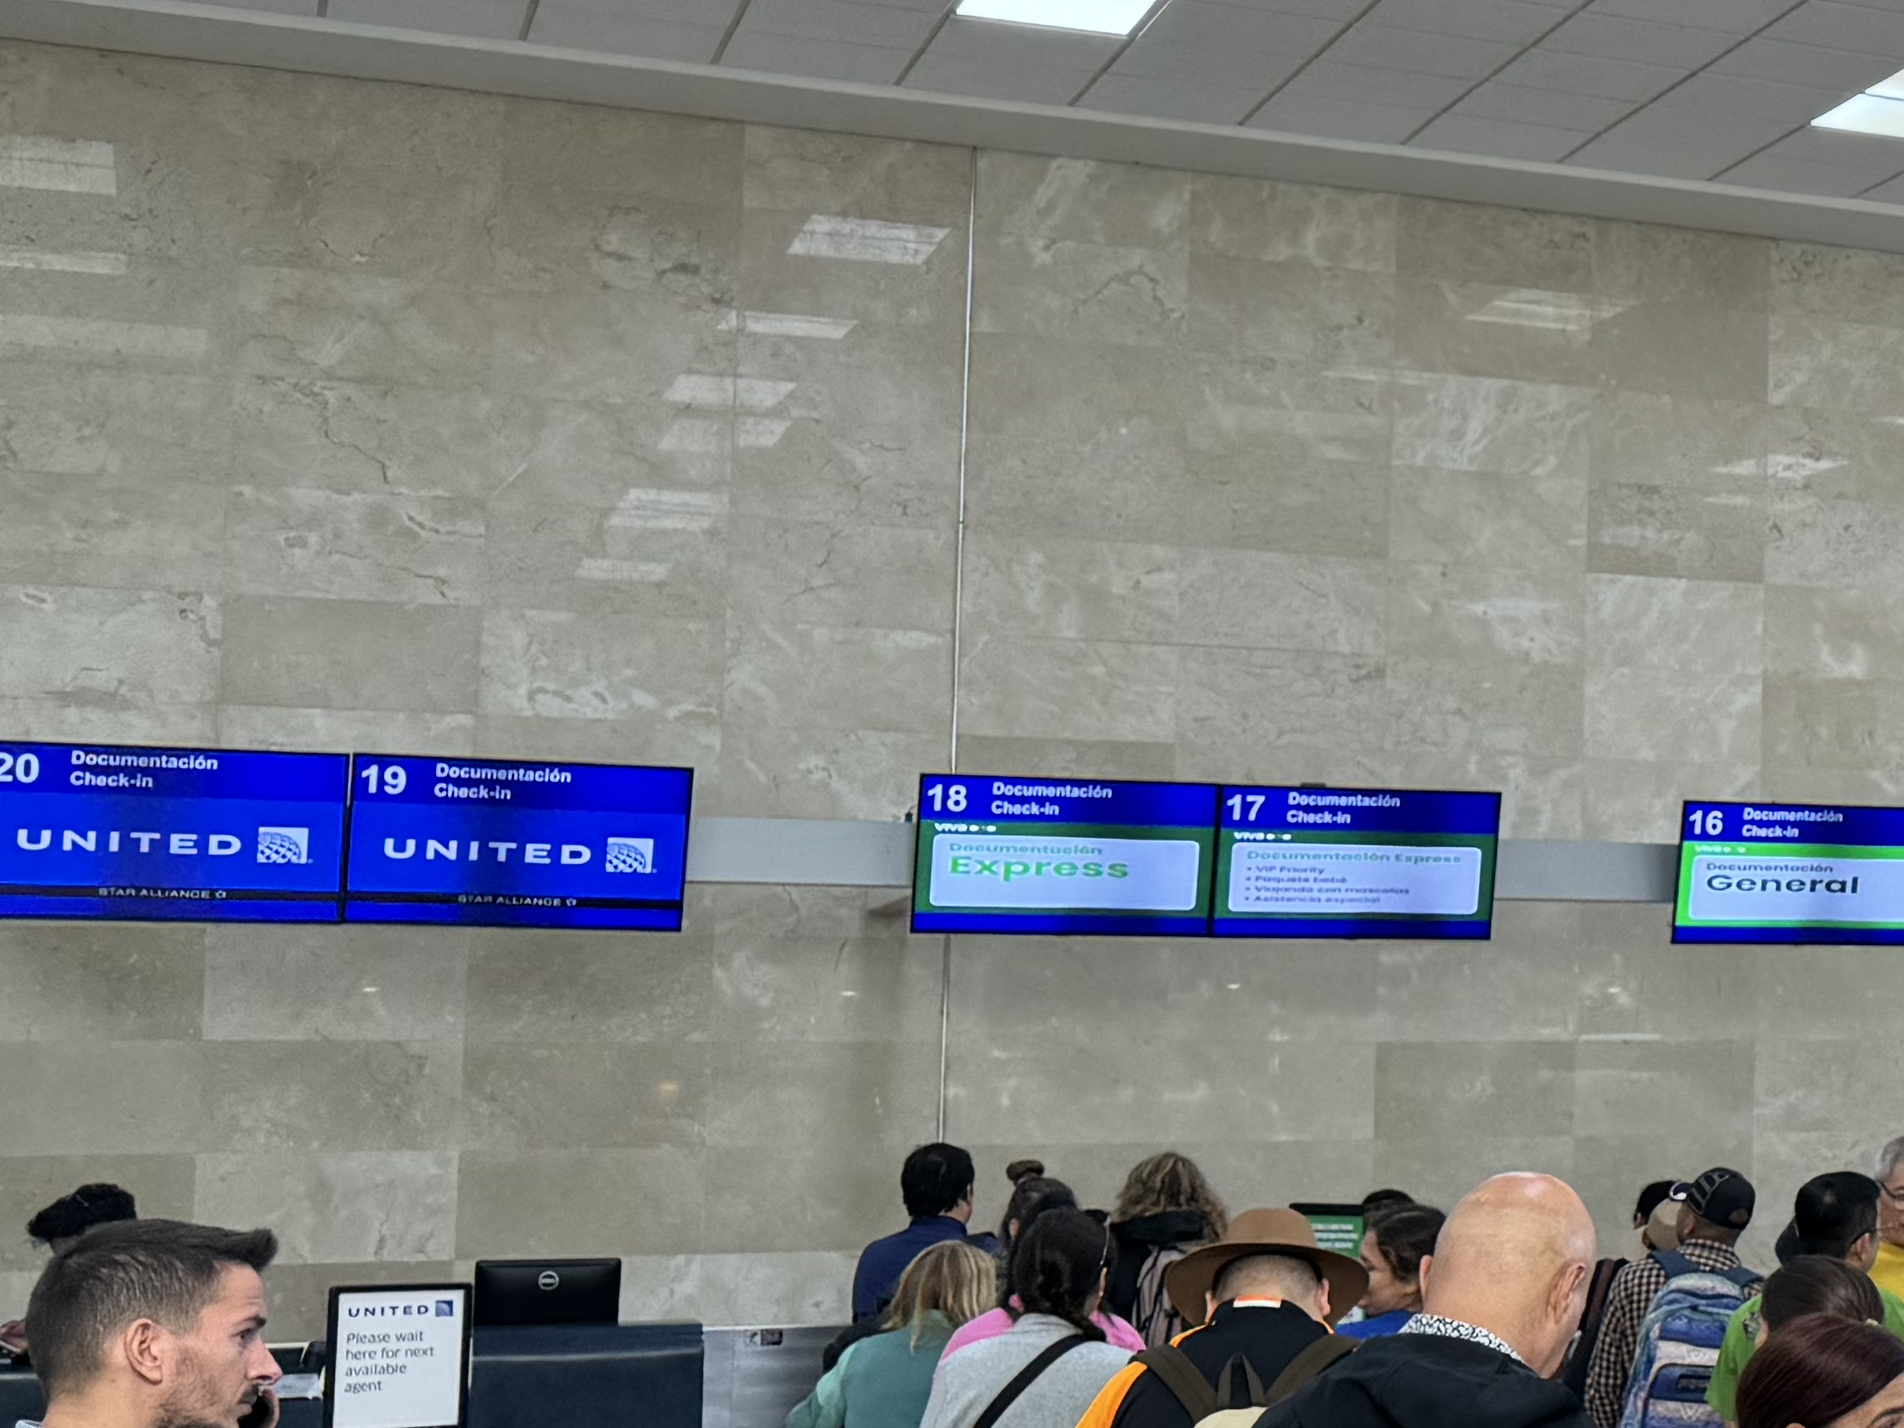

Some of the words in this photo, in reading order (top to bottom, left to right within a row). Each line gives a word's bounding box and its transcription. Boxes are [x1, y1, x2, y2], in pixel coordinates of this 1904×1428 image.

[71, 750, 218, 770] Documentación
[69, 771, 154, 788] Check-in
[360, 764, 407, 795] 19
[435, 763, 572, 784] Documentación
[434, 782, 512, 800] Check-in
[926, 783, 968, 812] 18
[992, 781, 1112, 799] Documentación
[990, 800, 1060, 816] Check-in
[1226, 794, 1266, 822] 17
[1288, 791, 1400, 808] Documentación
[1286, 810, 1351, 824] Check-in
[1688, 809, 1724, 836] 16
[1743, 807, 1843, 822] Documentación
[1742, 824, 1799, 838] Check-in
[16, 828, 242, 856] UNITED
[950, 842, 1102, 856] Documentación
[383, 837, 592, 865] UNITED
[950, 856, 1129, 882] Express
[1706, 862, 1833, 874] Documentación
[98, 887, 136, 897] STAR
[139, 888, 211, 899] ALLIANCE
[1706, 874, 1859, 895] General
[457, 894, 493, 904] STAR
[496, 895, 562, 907] ALLIANCE
[348, 1305, 429, 1317] UNITED
[347, 1332, 390, 1344] Please
[395, 1331, 424, 1342] wait
[345, 1349, 377, 1361] here
[380, 1348, 401, 1359] for
[405, 1347, 434, 1357] next
[345, 1364, 407, 1377] available
[344, 1381, 382, 1394] agent
